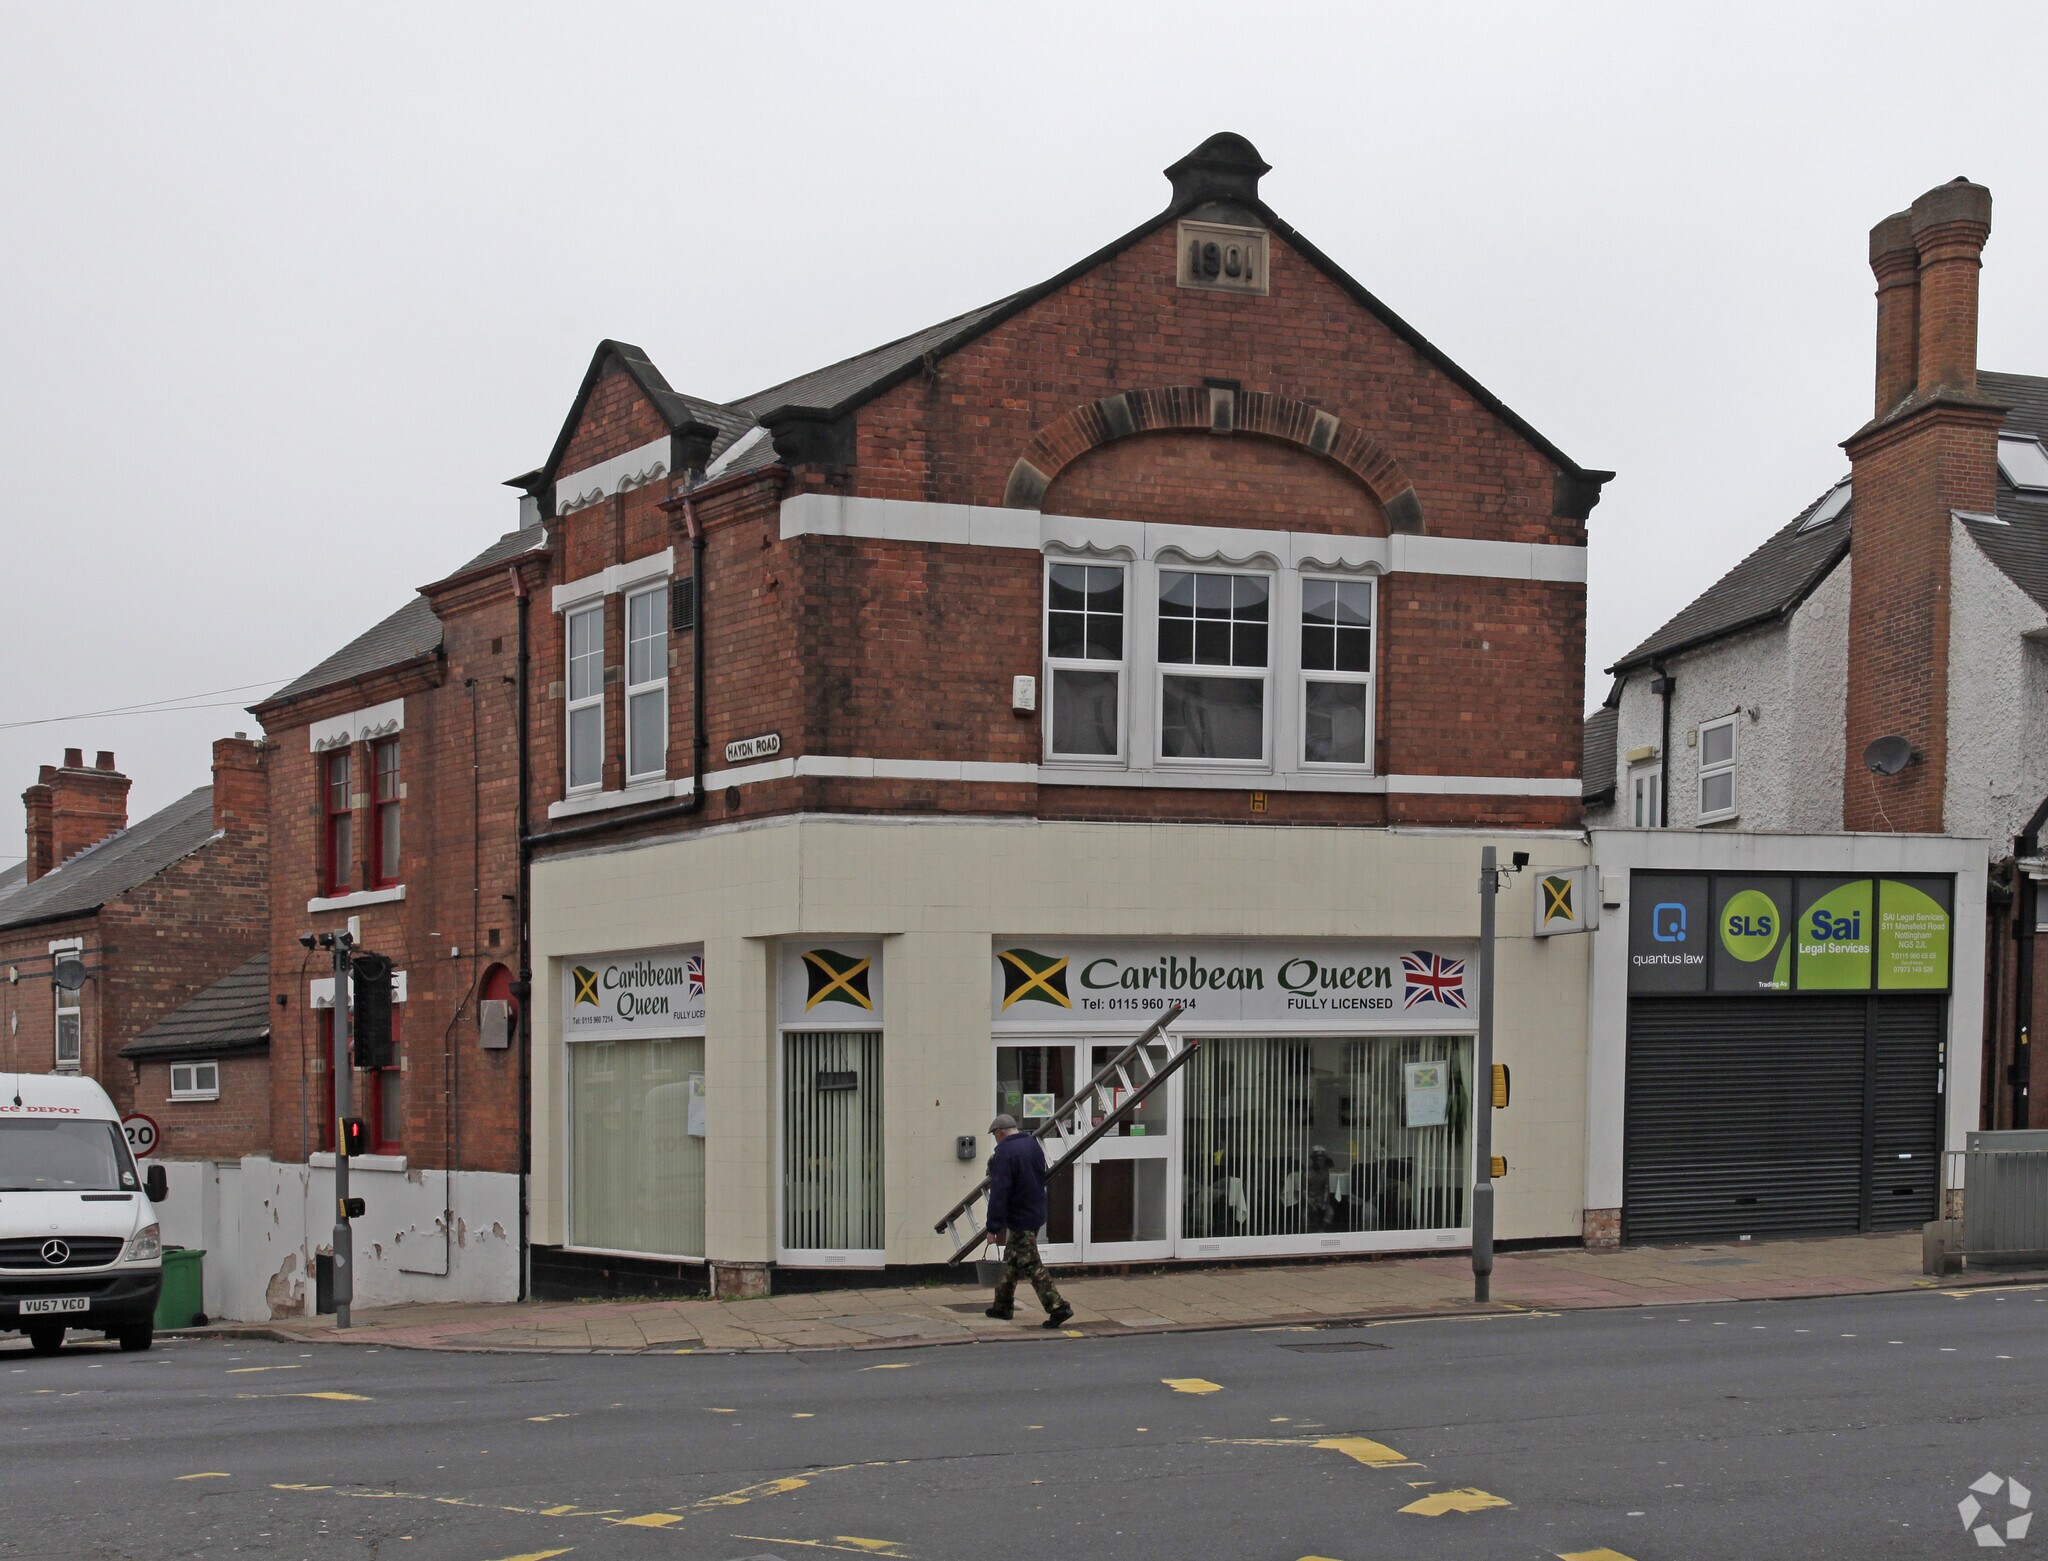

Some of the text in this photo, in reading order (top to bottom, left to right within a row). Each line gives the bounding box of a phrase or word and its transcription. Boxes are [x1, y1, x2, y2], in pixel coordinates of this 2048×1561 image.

[1189, 239, 1253, 280] 1901
[727, 736, 778, 759] HAYDN ROAD
[1897, 913, 1915, 922] Legal
[1916, 913, 1944, 921] Services
[1728, 915, 1772, 937] SLS
[1811, 910, 1861, 941] Sai
[1882, 922, 1946, 931] 511 Mansfield Road
[1895, 931, 1932, 940] Nottingham
[1799, 942, 1870, 956] Legal Services
[1898, 940, 1927, 949] NG5 2JL
[1632, 952, 1704, 967] quantus law
[603, 960, 684, 990] Caribbean
[1080, 955, 1393, 998] Caribbean Queen
[1758, 980, 1788, 990] Trading As
[617, 991, 669, 1022] Queen
[1081, 998, 1105, 1010] Tel:
[1108, 998, 1138, 1010] 0115
[1141, 998, 1164, 1010] 960
[1287, 998, 1393, 1010] FULLY LICENSED
[673, 1009, 706, 1020] FULLY LICE
[26, 1106, 80, 1114] DEPOT
[125, 1126, 153, 1145] 20
[25, 1300, 58, 1312] VU57
